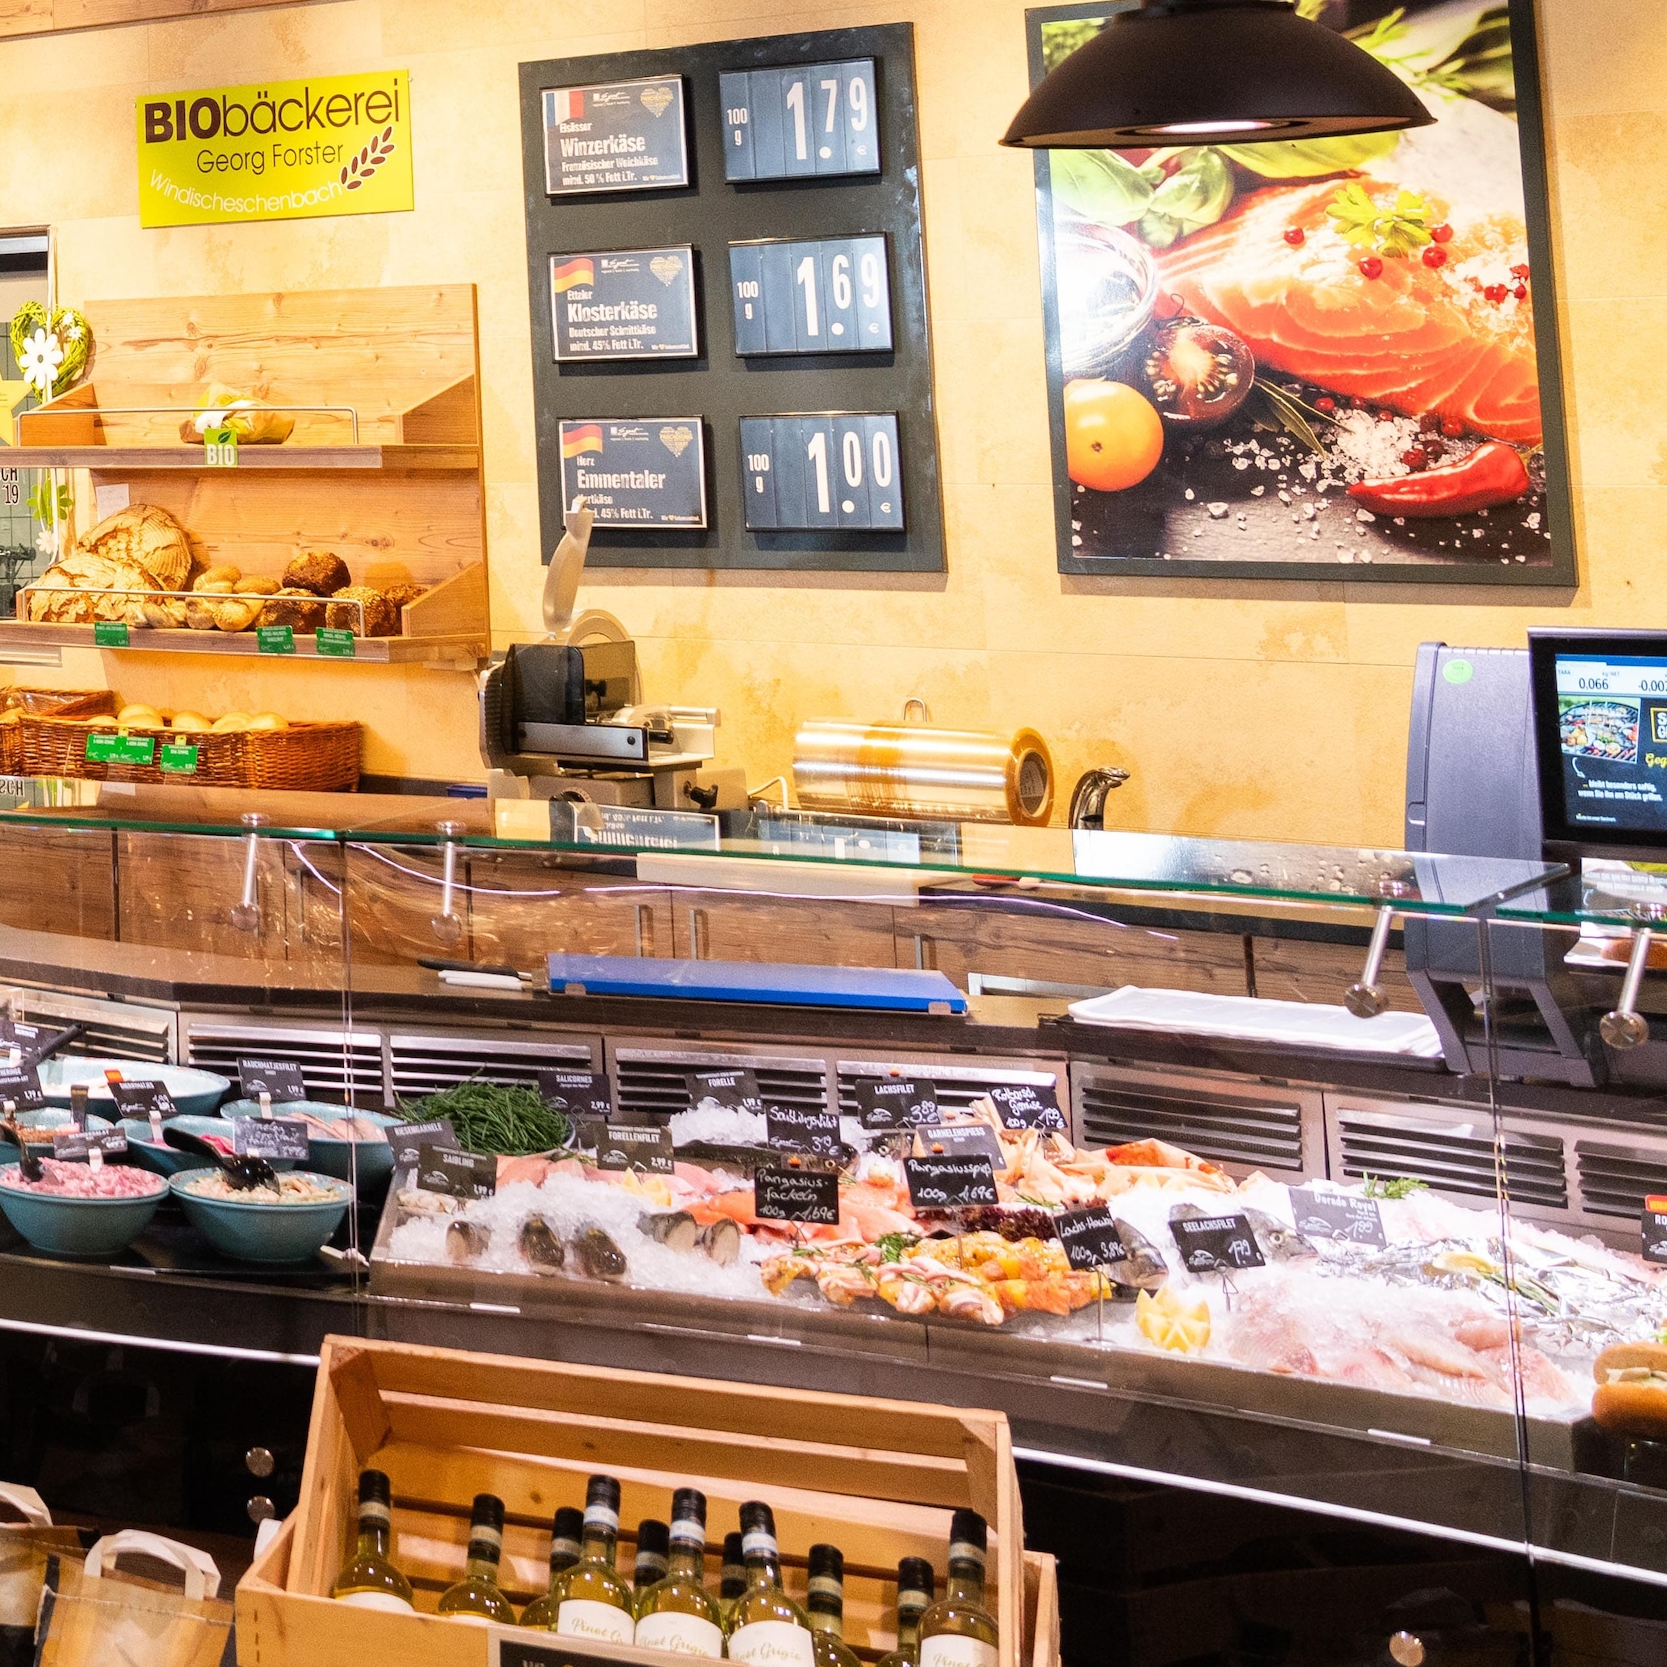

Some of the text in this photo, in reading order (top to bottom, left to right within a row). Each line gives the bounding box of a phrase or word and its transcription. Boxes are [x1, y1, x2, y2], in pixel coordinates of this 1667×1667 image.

[144, 78, 400, 144] BIObäckerei
[726, 107, 748, 125] 100
[560, 134, 646, 157] Winzerkäse
[197, 140, 344, 175] Georg Forster
[561, 155, 658, 172] Französischer Weichkäse
[585, 173, 595, 184] 50
[605, 172, 622, 183] Fett
[150, 168, 342, 213] Windischeschenbach
[736, 280, 759, 299] 100
[568, 301, 658, 323] Klosterkäse
[612, 339, 627, 350] Fett
[576, 456, 595, 467] Herz
[747, 453, 770, 472] 100
[577, 469, 666, 489] Emmentaler
[620, 507, 637, 519] Fett
[1579, 678, 1608, 690] 0,066
[556, 1074, 593, 1084] SALICORNES
[708, 1076, 735, 1087] FORELLE
[874, 1084, 915, 1095] LACHSFILET
[608, 1131, 660, 1143] FORELLENFILET
[442, 1154, 475, 1168] SAIBLING
[1350, 1198, 1377, 1213] Royal
[1182, 1218, 1237, 1233] SEELACHSFILET
[572, 1618, 607, 1636] Pinot
